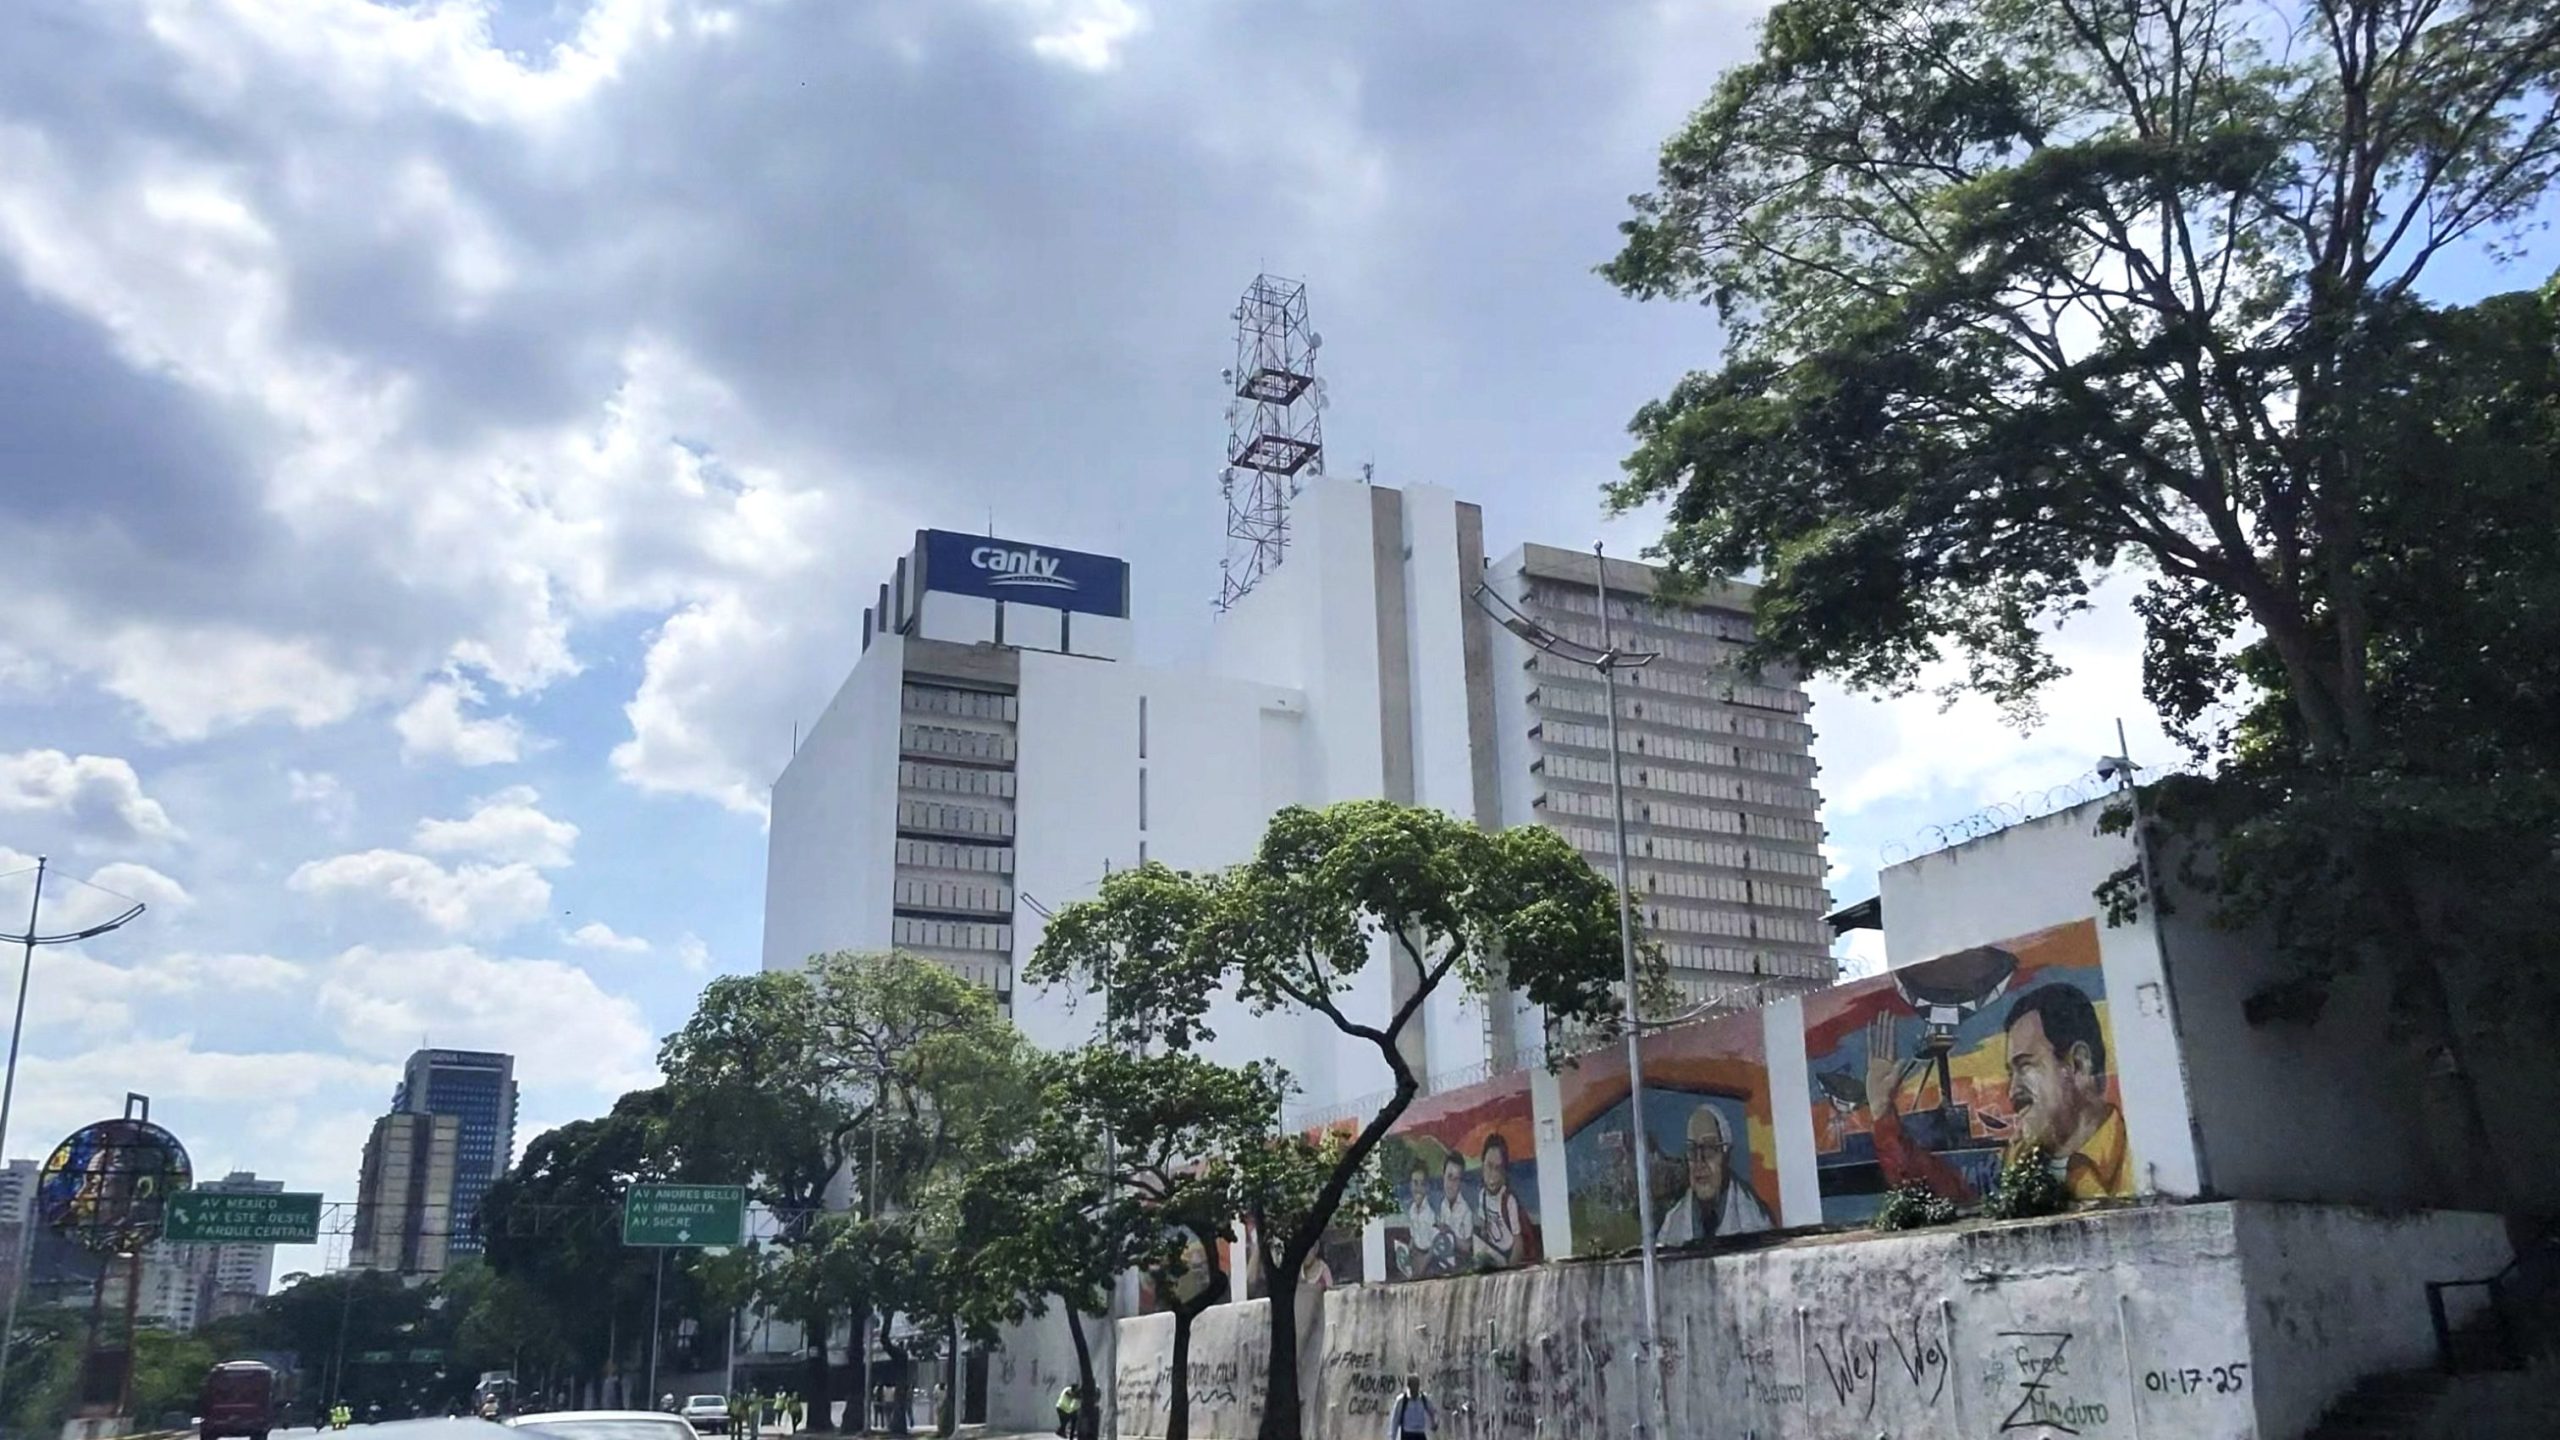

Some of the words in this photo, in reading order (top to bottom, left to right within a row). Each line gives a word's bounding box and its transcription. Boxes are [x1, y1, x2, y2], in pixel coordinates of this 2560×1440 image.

[971, 546, 1060, 577] cantv
[655, 1189, 700, 1199] ANDRES
[703, 1190, 739, 1200] BELLO
[226, 1198, 278, 1209] MEXICO
[653, 1203, 715, 1213] URDANETA
[653, 1217, 692, 1227] SUCRE
[195, 1225, 251, 1236] PARQUE
[255, 1226, 314, 1237] CENTRAL
